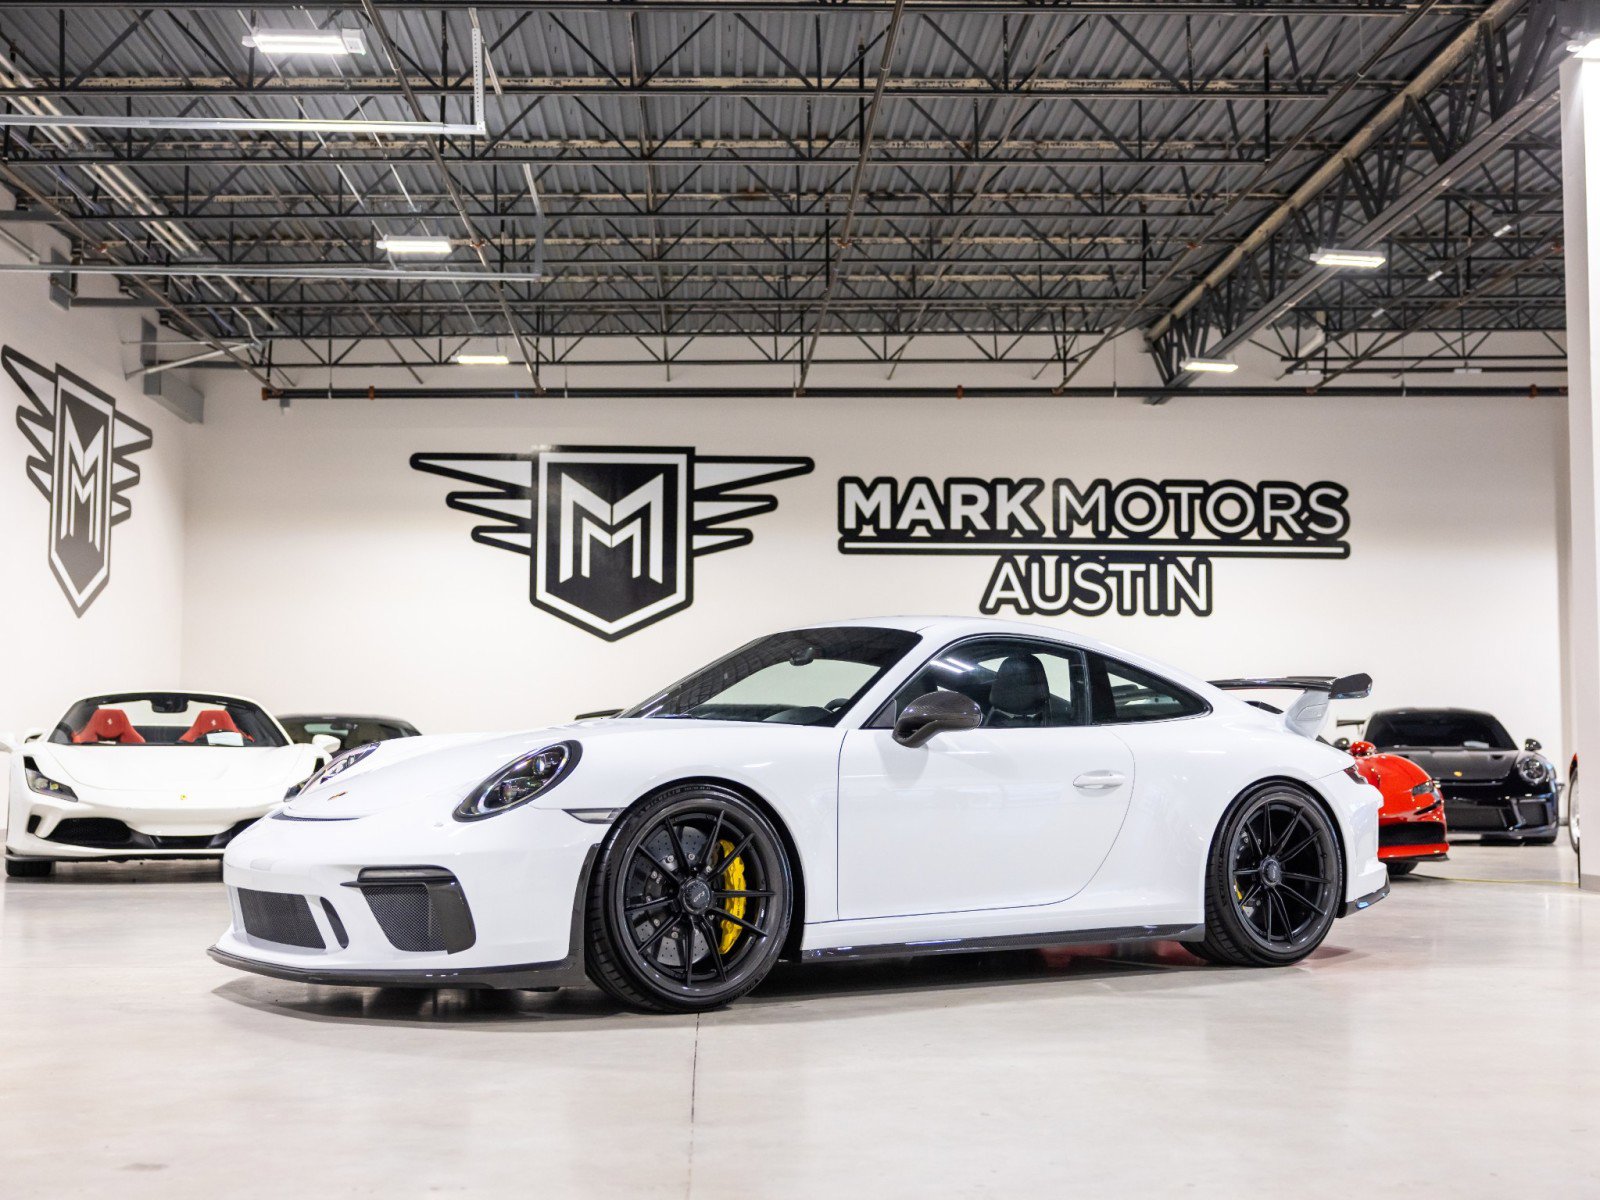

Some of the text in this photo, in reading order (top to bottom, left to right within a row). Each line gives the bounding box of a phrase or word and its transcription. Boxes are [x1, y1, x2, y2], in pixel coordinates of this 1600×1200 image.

[842, 480, 1346, 536] MARK MOTORS
[983, 559, 1209, 614] AUSTIN
